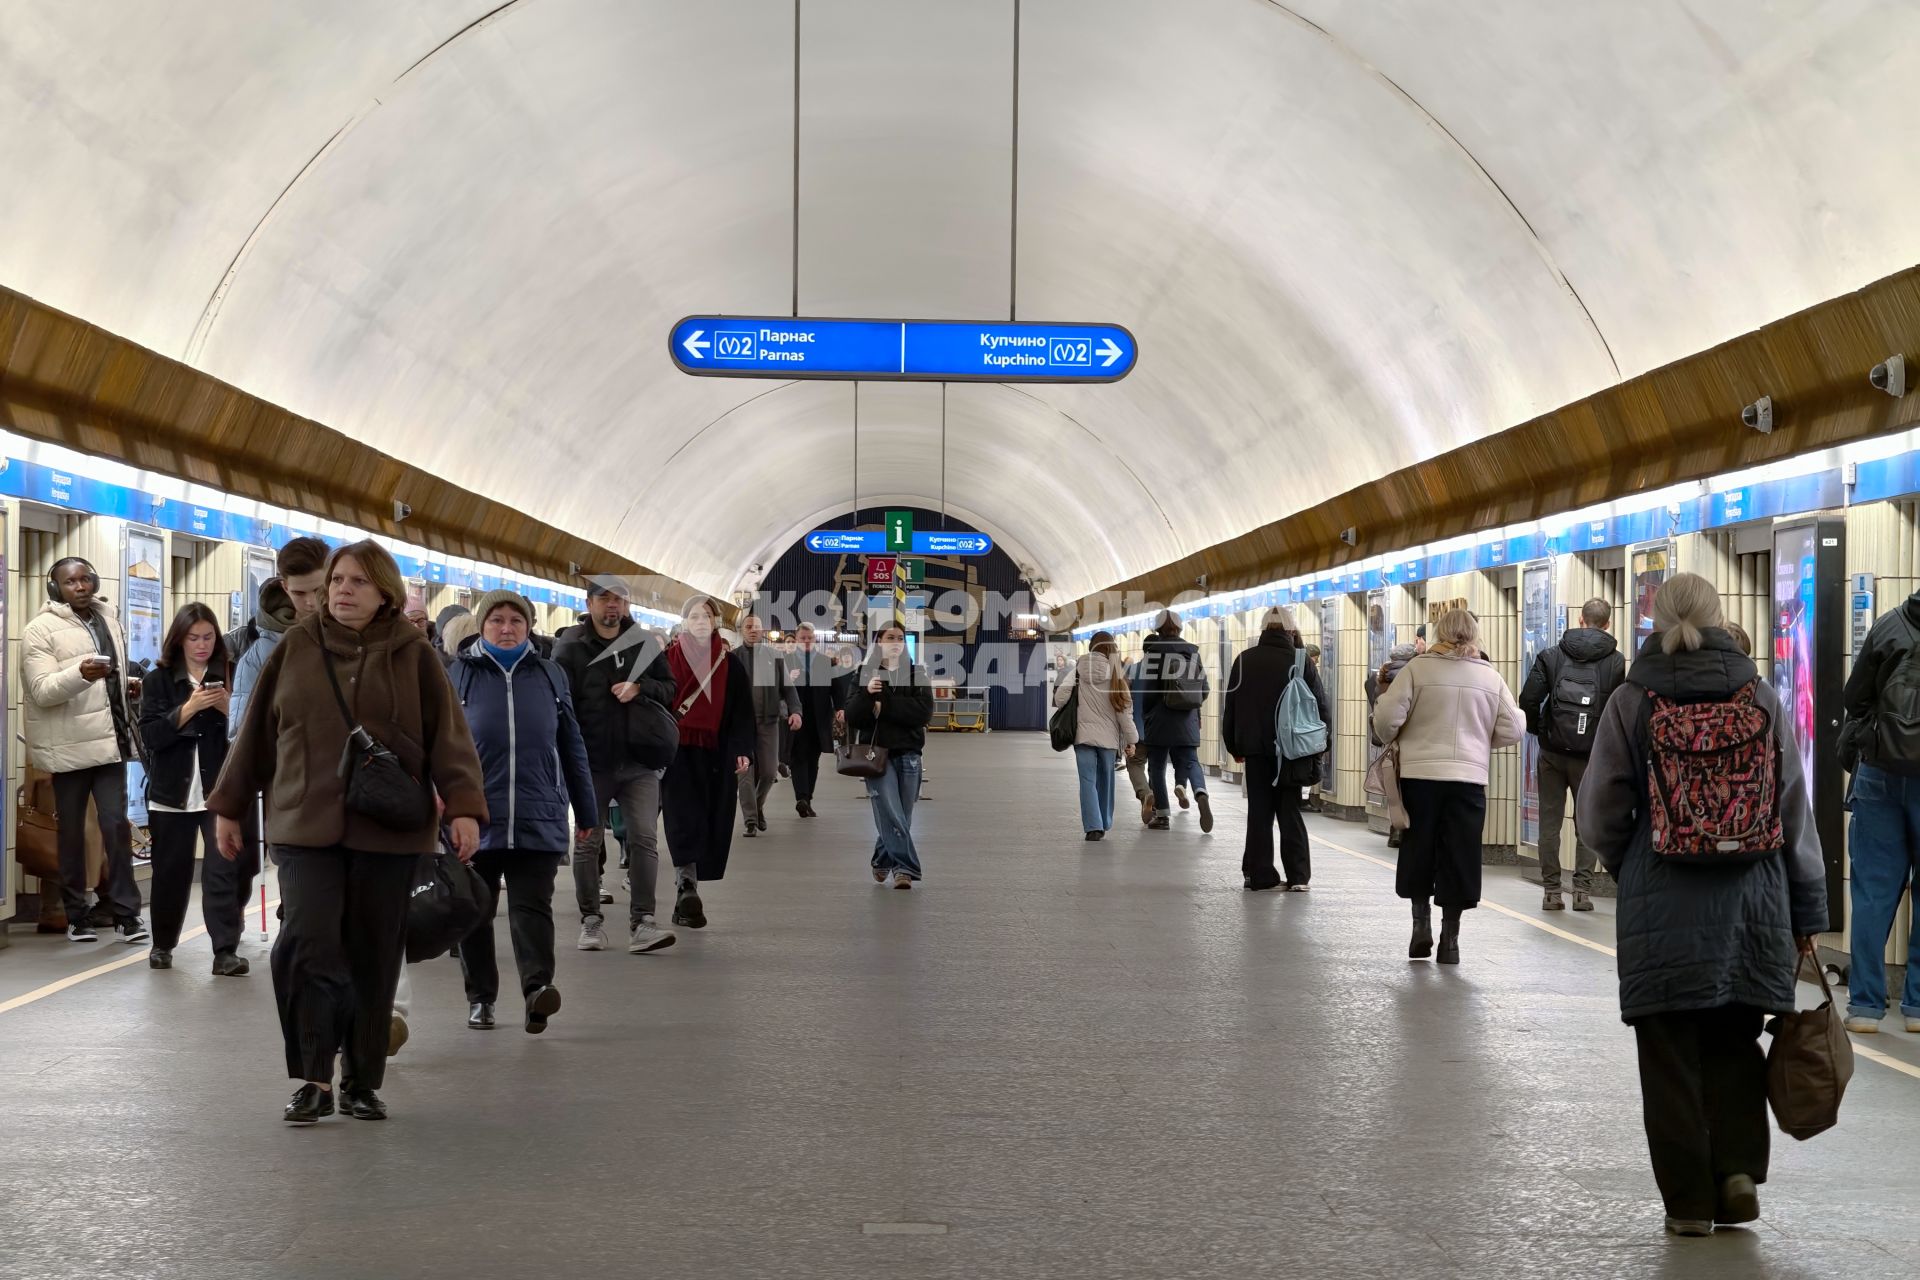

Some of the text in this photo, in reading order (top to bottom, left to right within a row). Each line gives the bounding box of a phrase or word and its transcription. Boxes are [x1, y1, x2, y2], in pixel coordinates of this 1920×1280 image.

[760, 329, 815, 345] Парнас
[980, 333, 1046, 349] Купчино
[760, 350, 805, 361] Parnas
[983, 354, 1046, 368] Kupchino
[873, 572, 890, 580] SOS
